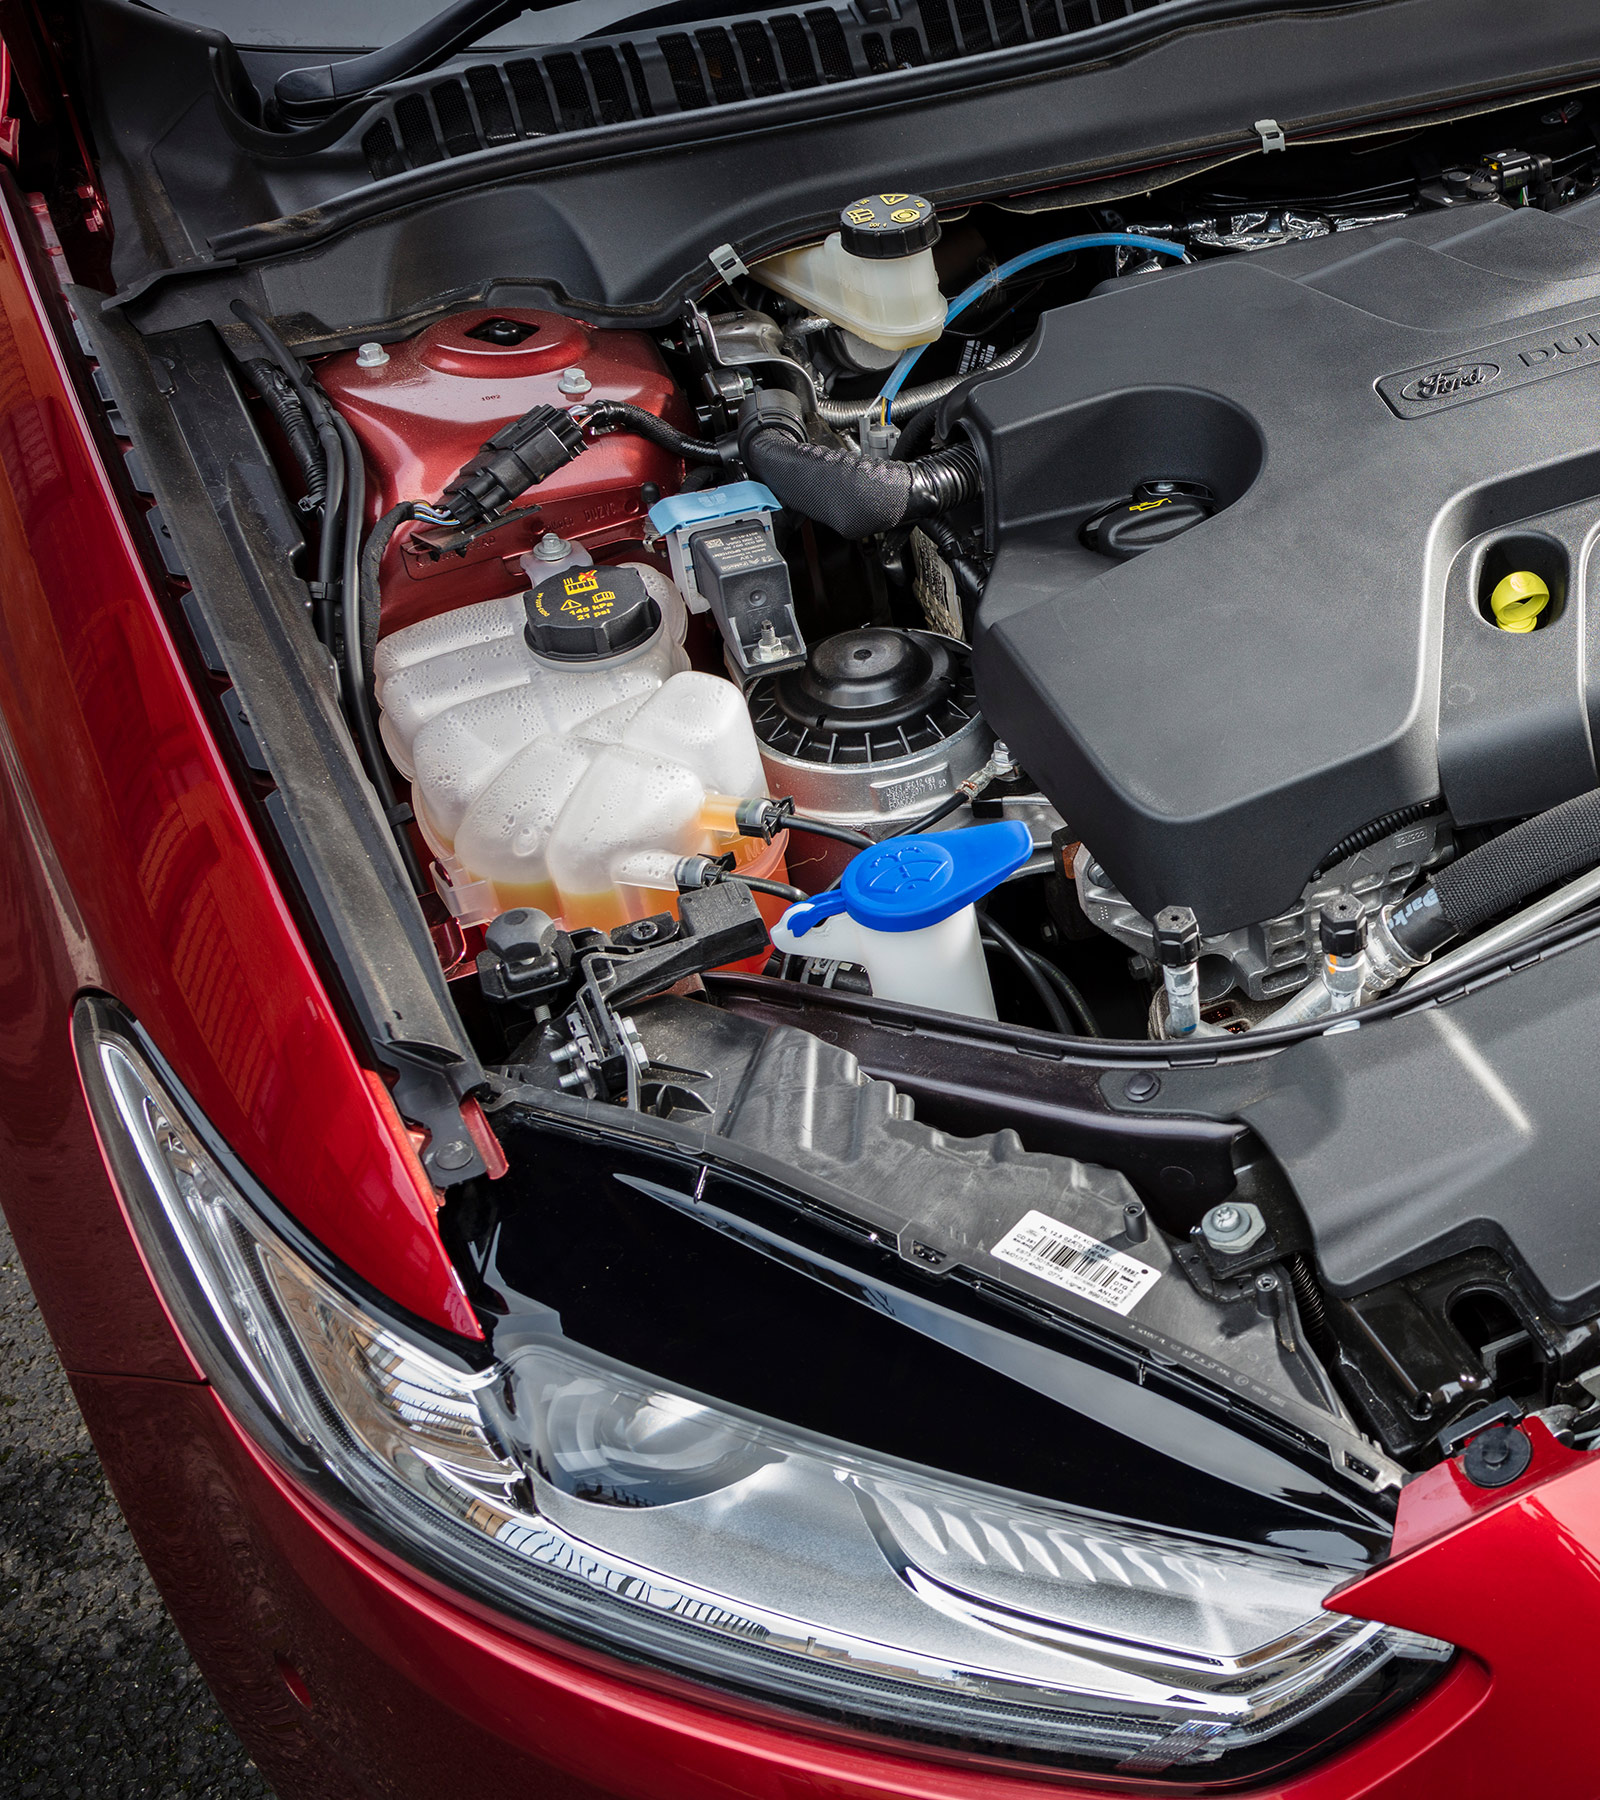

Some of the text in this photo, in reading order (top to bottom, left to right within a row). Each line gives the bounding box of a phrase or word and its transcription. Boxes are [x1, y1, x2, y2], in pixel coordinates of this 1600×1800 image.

[1416, 365, 1485, 399] Ford
[569, 602, 614, 616] 145 kPa
[577, 608, 611, 621] 21 psi
